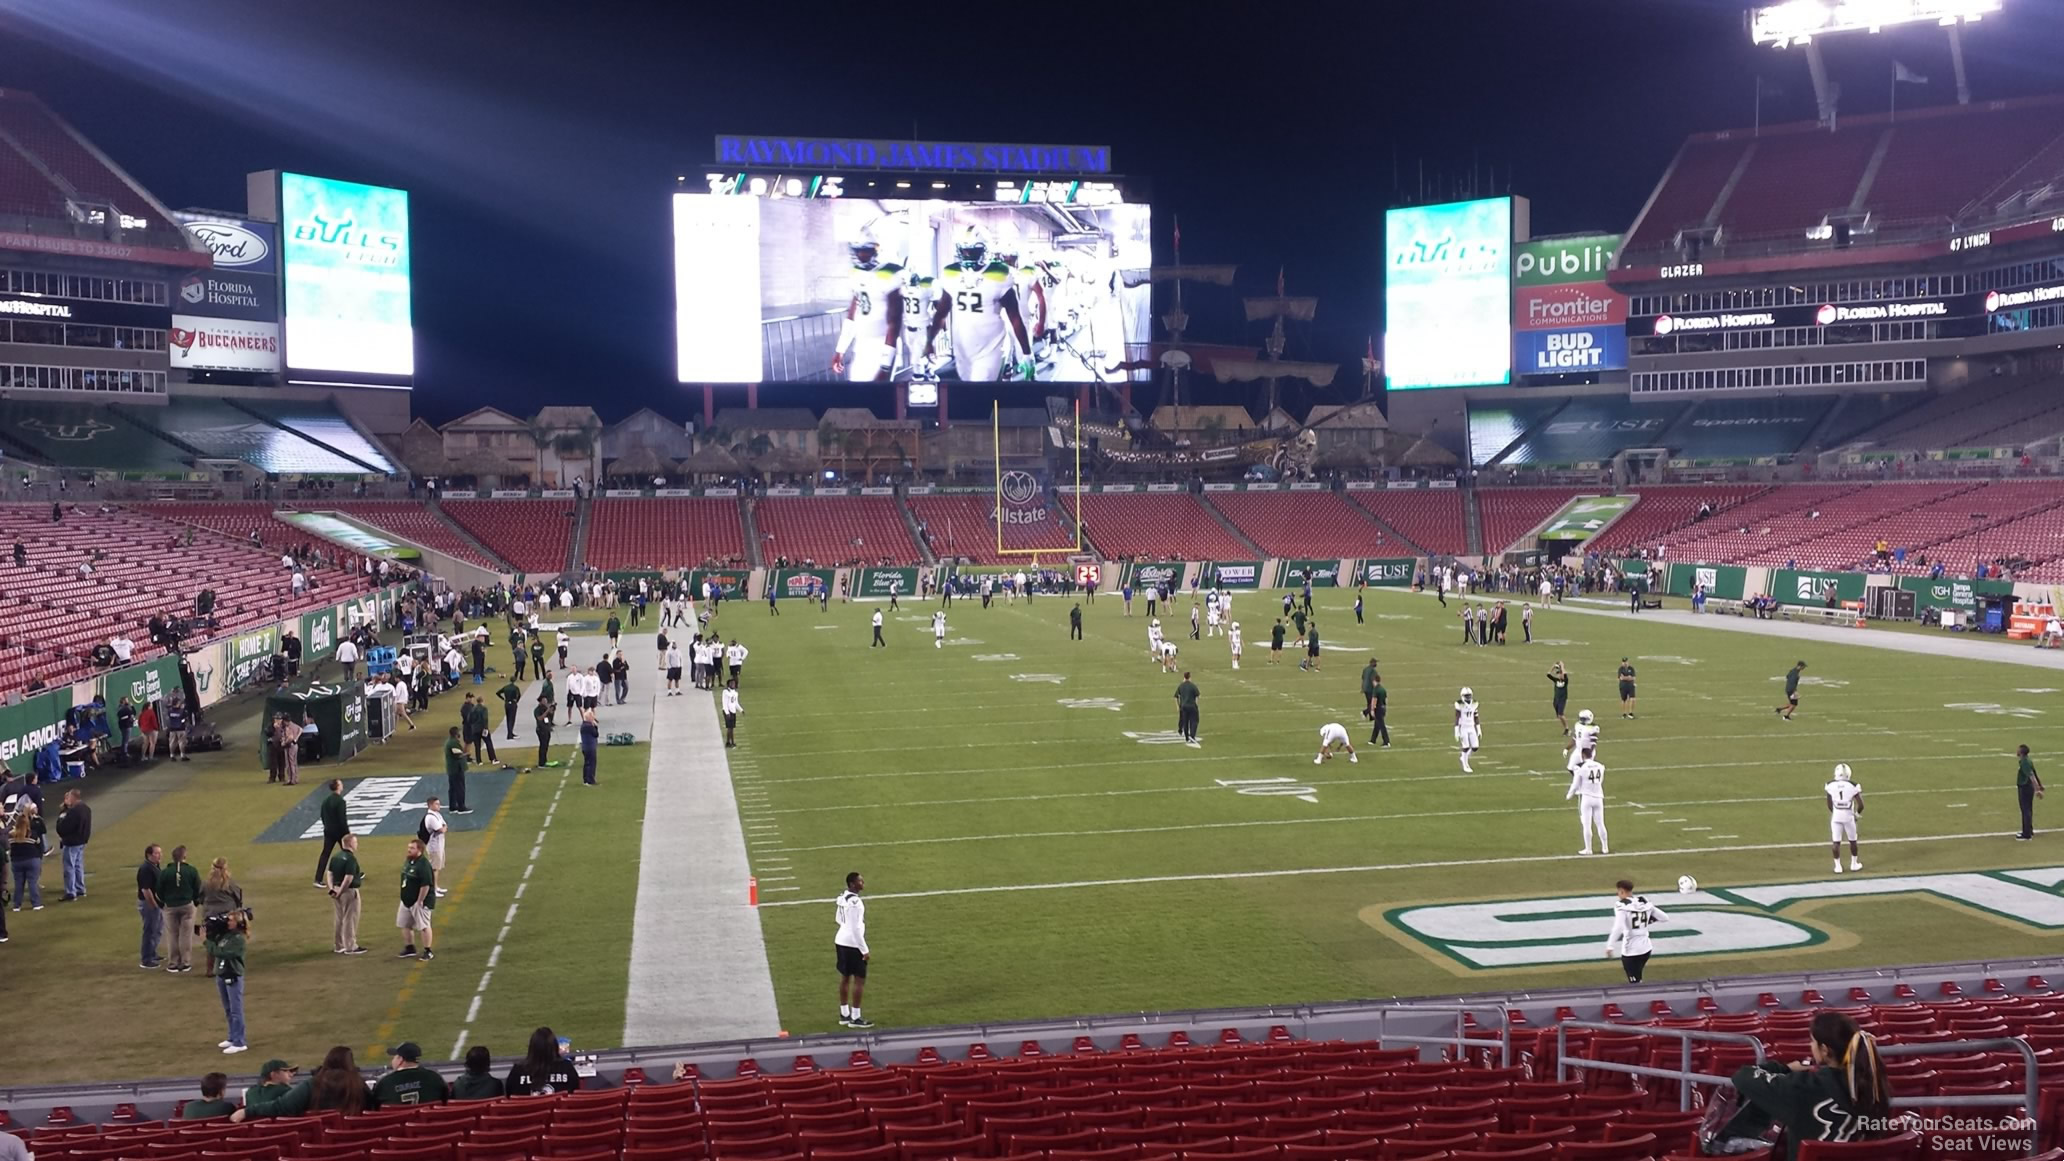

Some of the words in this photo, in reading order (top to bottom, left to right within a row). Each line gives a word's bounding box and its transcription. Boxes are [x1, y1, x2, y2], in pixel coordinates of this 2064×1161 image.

[720, 137, 877, 167] RAYMOND
[879, 142, 977, 169] JAMES
[982, 146, 1108, 172] STADIUM
[33, 238, 76, 252] ISSUES
[78, 242, 94, 253] TO
[1950, 238, 1961, 251] 47
[1964, 231, 1990, 249] LYNCH
[1661, 264, 1703, 278] GLAZER
[207, 279, 253, 295] FLORIDA
[208, 292, 260, 307] HOSPITAL
[956, 291, 984, 313] 52
[2000, 291, 2033, 307] FLORIDA
[1529, 296, 1612, 318] Frontier
[1837, 304, 1887, 320] FLORIDA
[1888, 302, 1947, 318] HOSPITAL
[1530, 313, 1608, 326] COMMUNICATIONS
[1673, 317, 1720, 331] FLORIDA
[1721, 313, 1776, 328] HOSPITAL
[198, 331, 277, 354] BUCCANEERS
[1547, 332, 1594, 351] BUD
[1538, 348, 1602, 369] LIGHT
[1692, 417, 1806, 428] Spectrum
[989, 506, 1046, 525] Allstate
[873, 570, 903, 579] Florida
[1080, 566, 1097, 580] 25
[1383, 564, 1409, 577] USF
[1697, 569, 1715, 584] USF
[873, 579, 889, 587] Blue
[1934, 586, 1951, 597] TGH
[1953, 583, 1971, 592] Tampa
[1953, 590, 1973, 600] General
[240, 634, 262, 658] HOME
[132, 679, 146, 698] TGH
[1588, 769, 1601, 784] 44
[1839, 790, 1843, 800] 1
[1631, 910, 1648, 930] 24
[519, 1073, 568, 1085] FLERS
